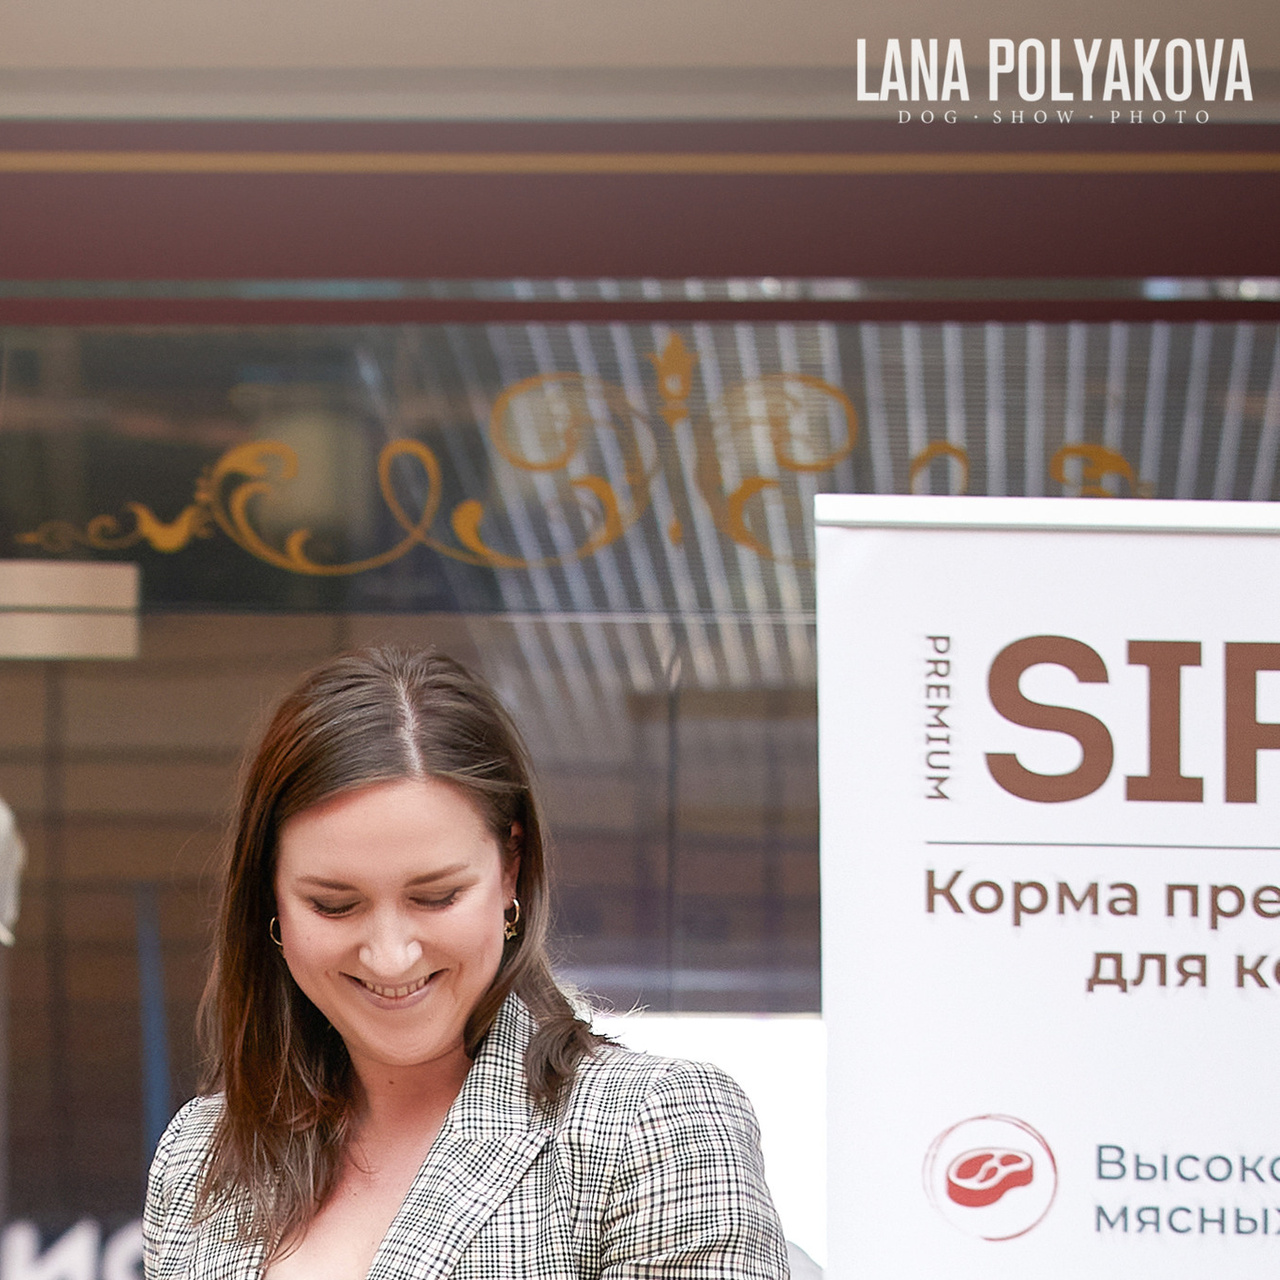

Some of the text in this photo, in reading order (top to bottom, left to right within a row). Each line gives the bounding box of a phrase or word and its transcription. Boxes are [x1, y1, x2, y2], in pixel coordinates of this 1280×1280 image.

[924, 634, 951, 801] PREMIUM
[925, 868, 1139, 927] Корма
[1086, 952, 1280, 993] для к
[1095, 1204, 1280, 1236] мясны
